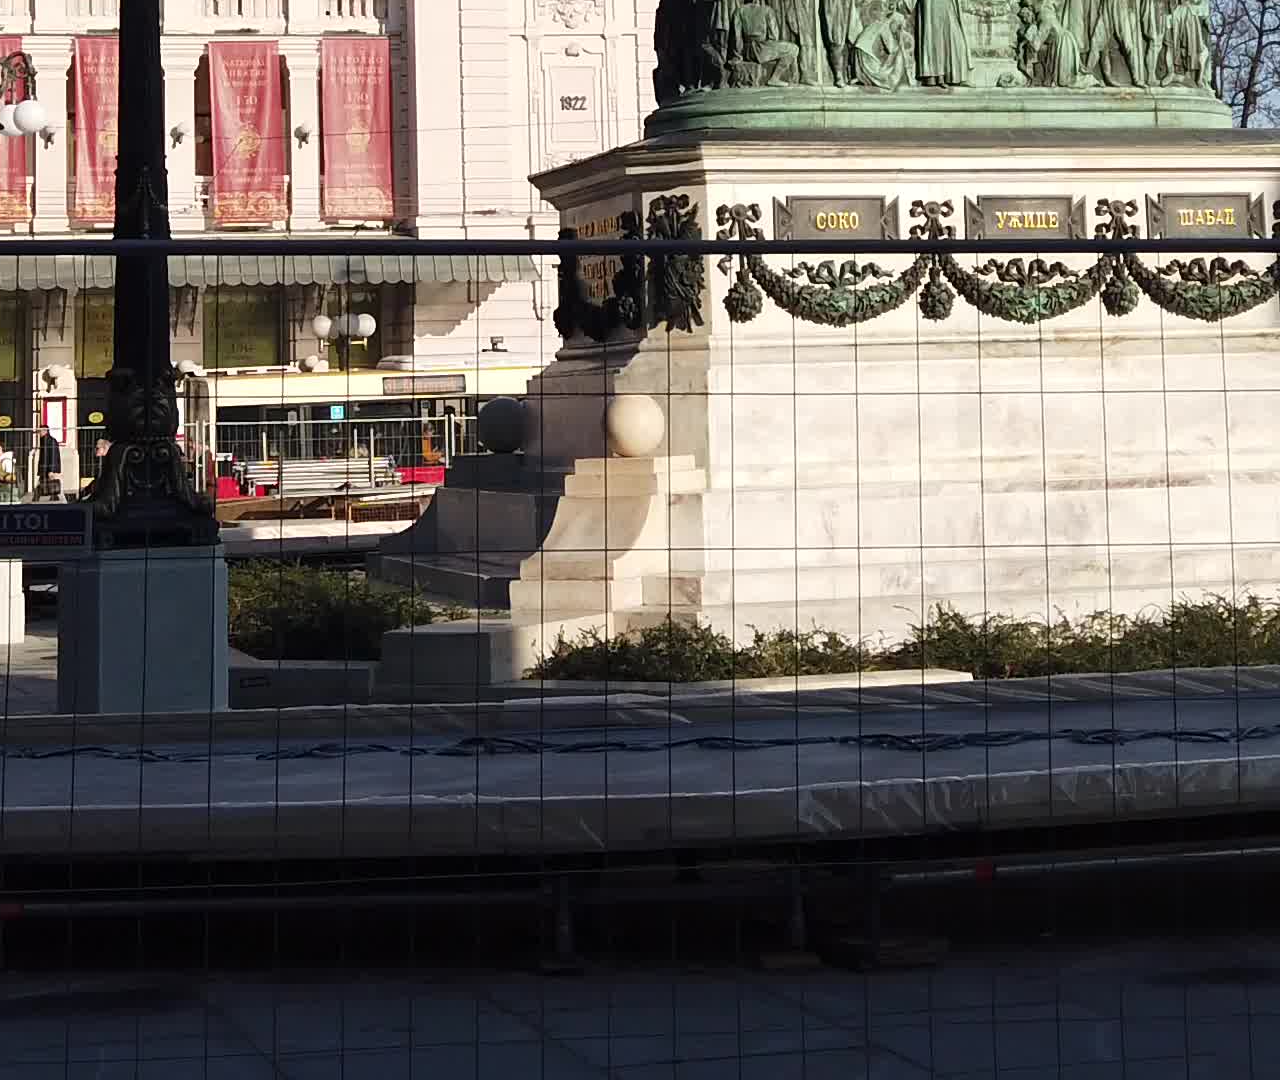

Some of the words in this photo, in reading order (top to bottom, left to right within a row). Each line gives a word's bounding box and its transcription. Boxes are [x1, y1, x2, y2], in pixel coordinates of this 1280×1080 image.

[560, 95, 587, 111] 1922
[816, 212, 859, 230] СОКО
[995, 211, 1059, 229] УЖИЦЕ
[1178, 208, 1236, 226] ШАБАЦ
[14, 513, 49, 530] TOI
